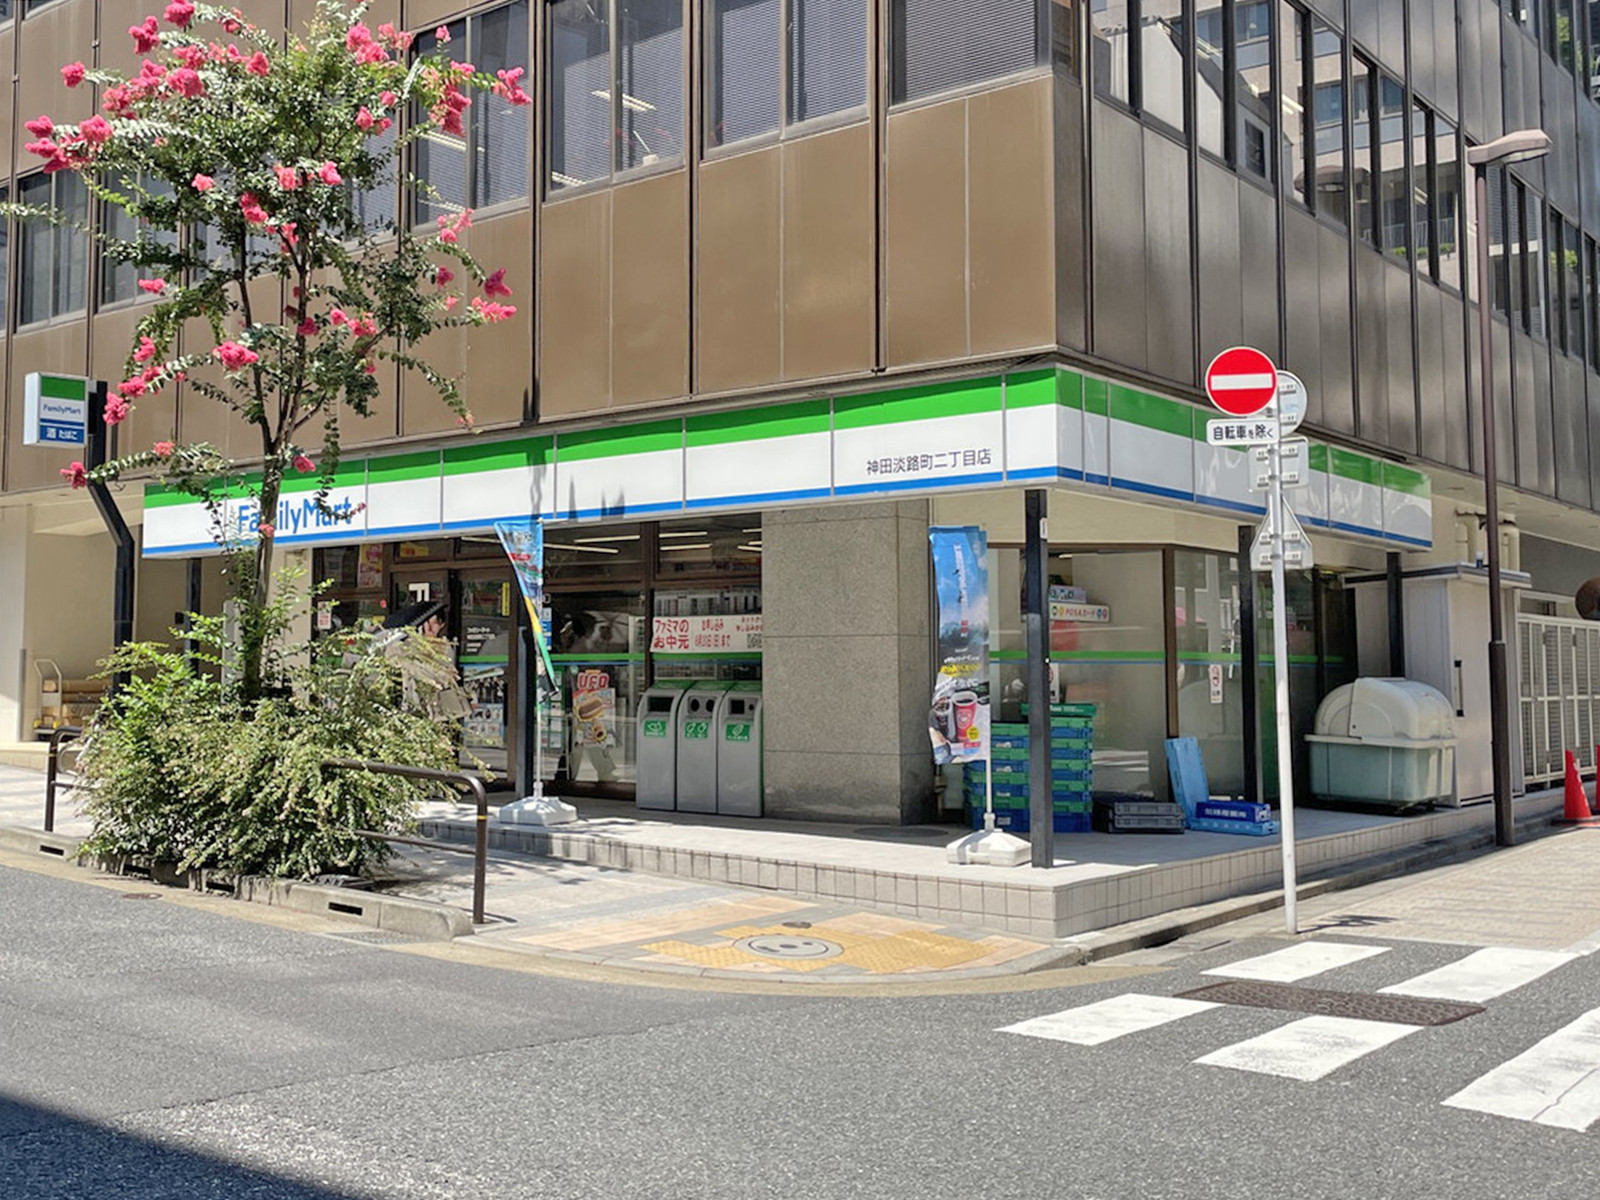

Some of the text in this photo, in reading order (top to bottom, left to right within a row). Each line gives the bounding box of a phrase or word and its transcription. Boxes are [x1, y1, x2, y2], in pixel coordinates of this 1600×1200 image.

[43, 404, 81, 414] FamilyMart
[1213, 424, 1273, 440] 自転車を除く
[866, 448, 992, 475] 神田淡路町二丁目店
[238, 496, 352, 534] FailyMart
[654, 619, 690, 633] ファミマの
[653, 634, 690, 650] お中元
